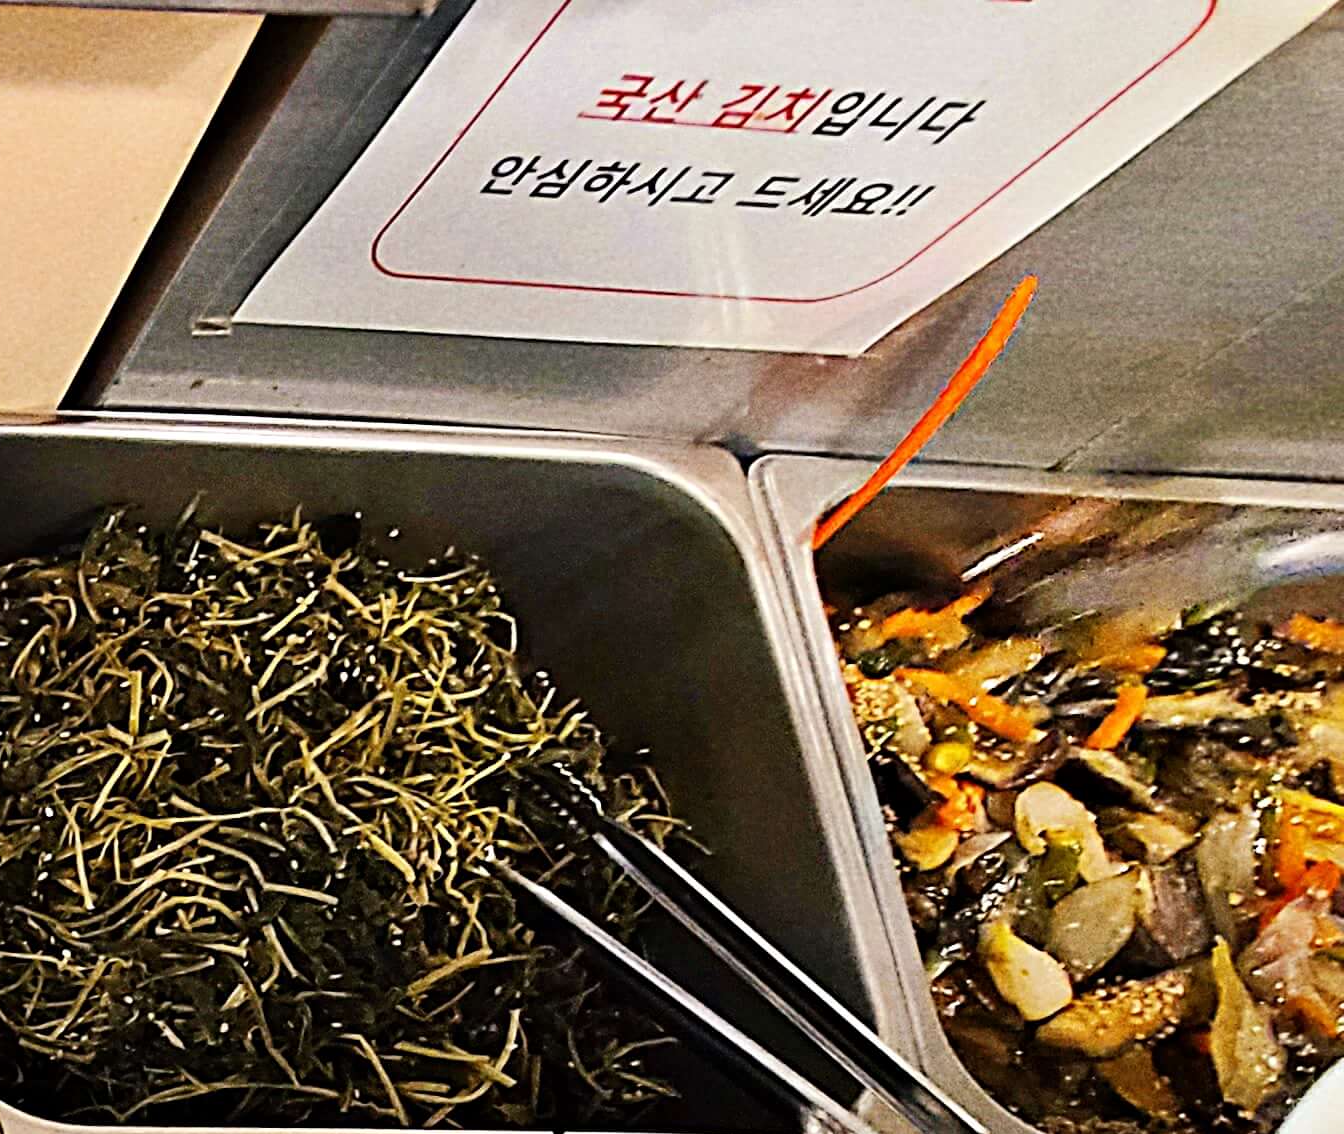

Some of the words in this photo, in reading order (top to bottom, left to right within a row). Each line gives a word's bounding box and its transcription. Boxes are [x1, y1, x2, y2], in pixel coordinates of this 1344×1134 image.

[594, 73, 709, 123] 국산
[712, 83, 987, 145] 김치입니다
[480, 155, 735, 206] 안심하시고
[736, 174, 936, 217] 드세요!!
